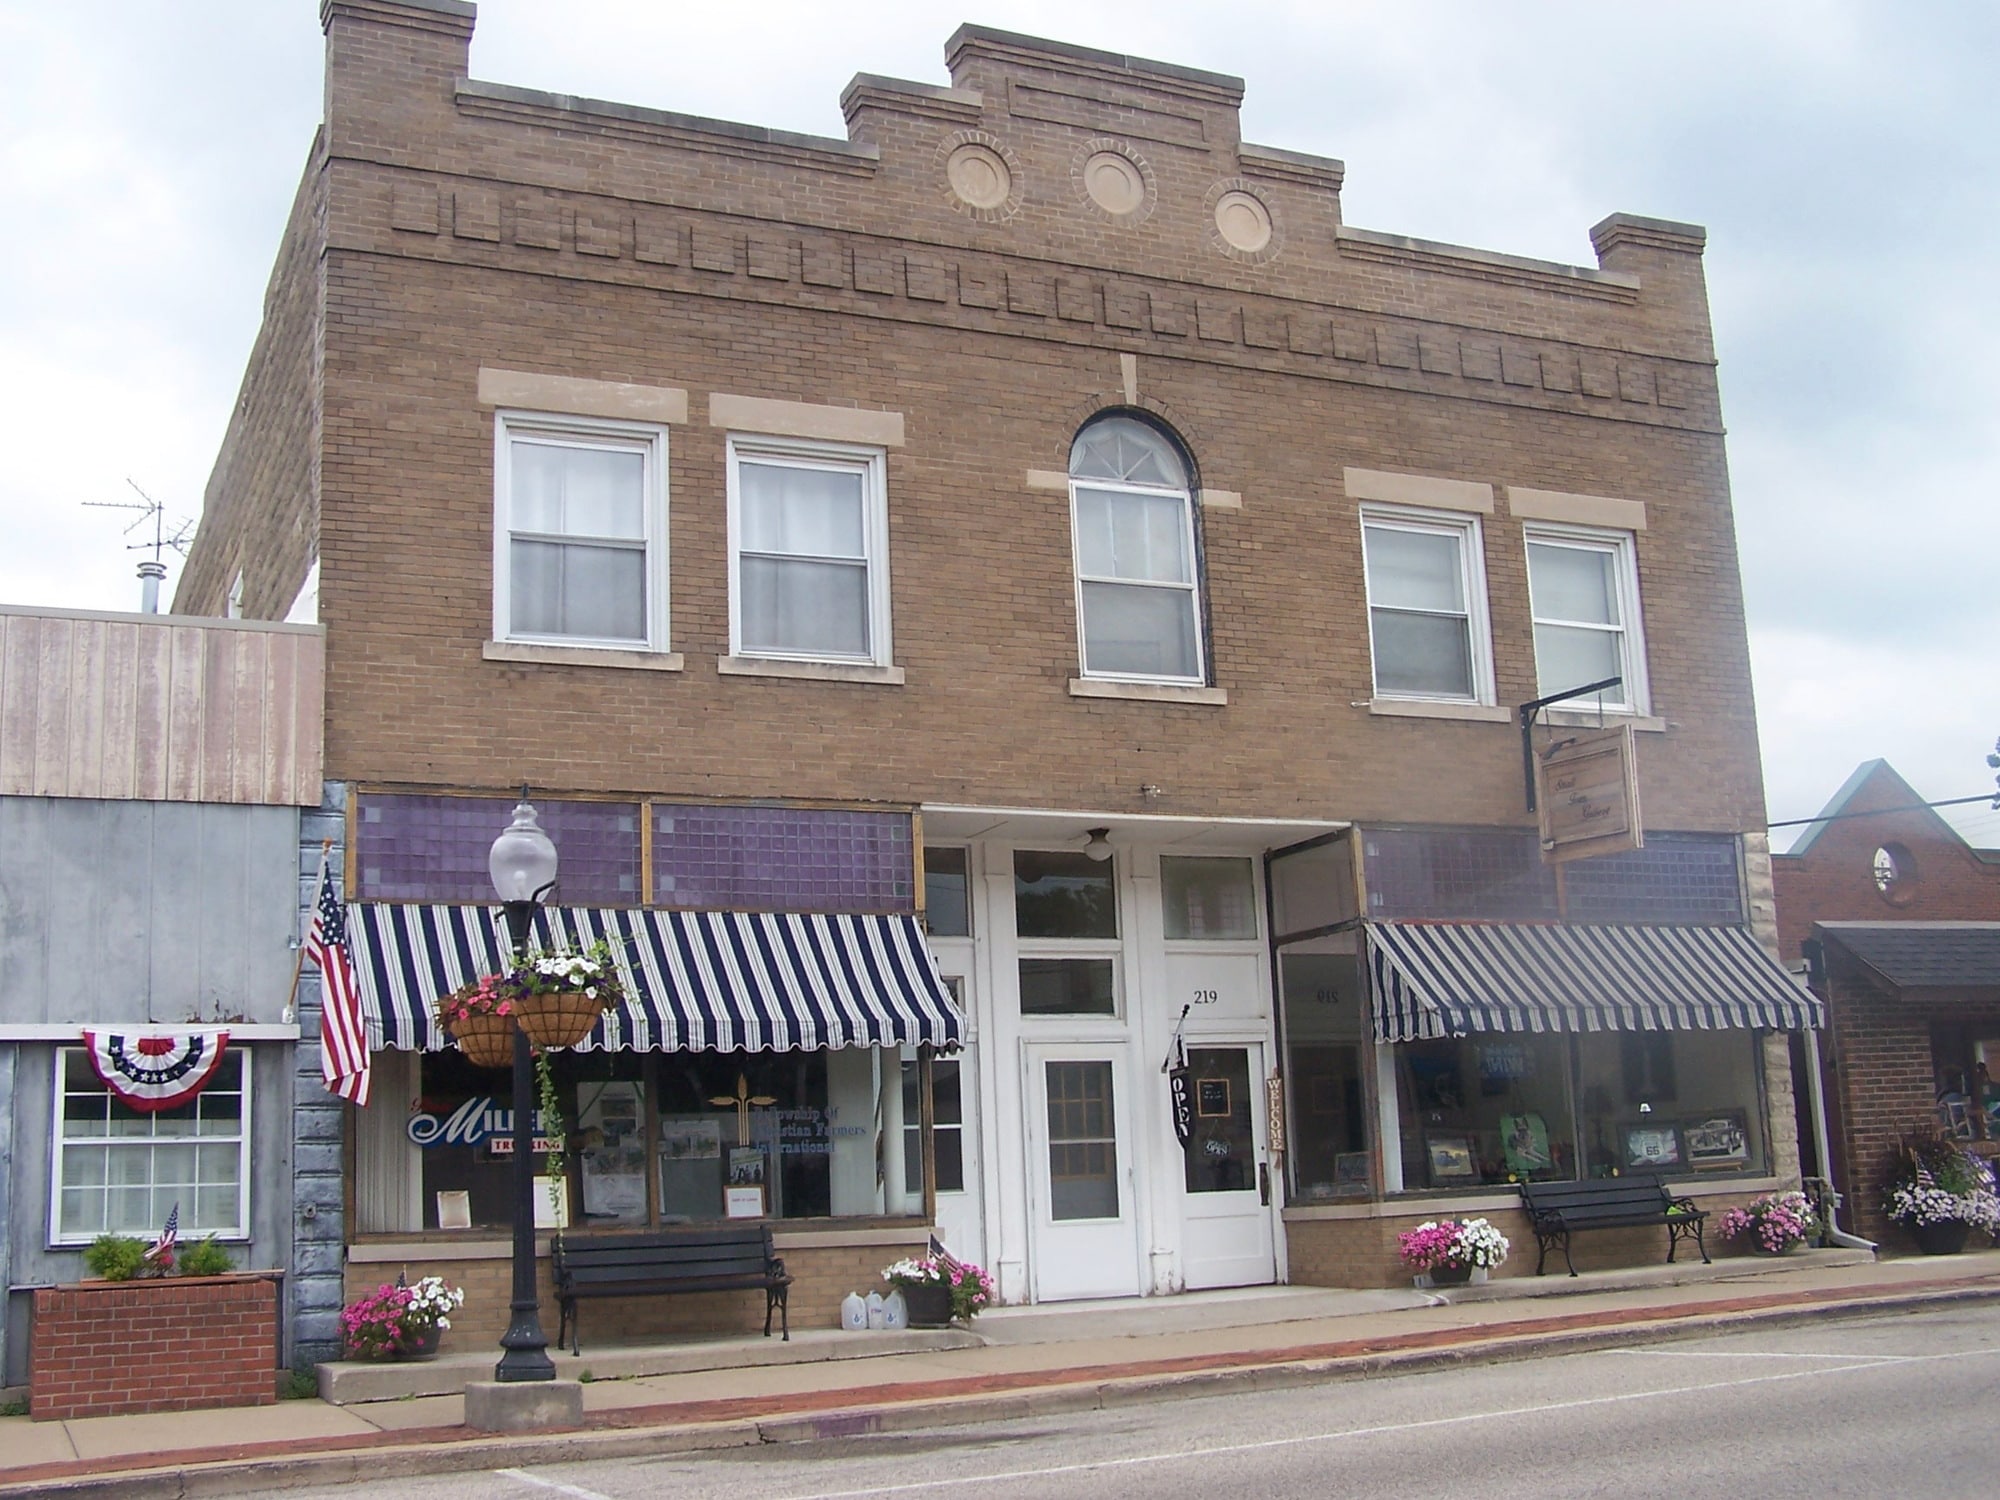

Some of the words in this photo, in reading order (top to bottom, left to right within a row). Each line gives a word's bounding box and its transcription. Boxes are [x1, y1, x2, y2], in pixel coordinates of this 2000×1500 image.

[1194, 990, 1217, 1004] 219
[408, 1096, 552, 1144] MILL
[1268, 1080, 1282, 1149] WELCOME
[495, 1141, 560, 1150] TRING
[1646, 1146, 1660, 1156] 66
